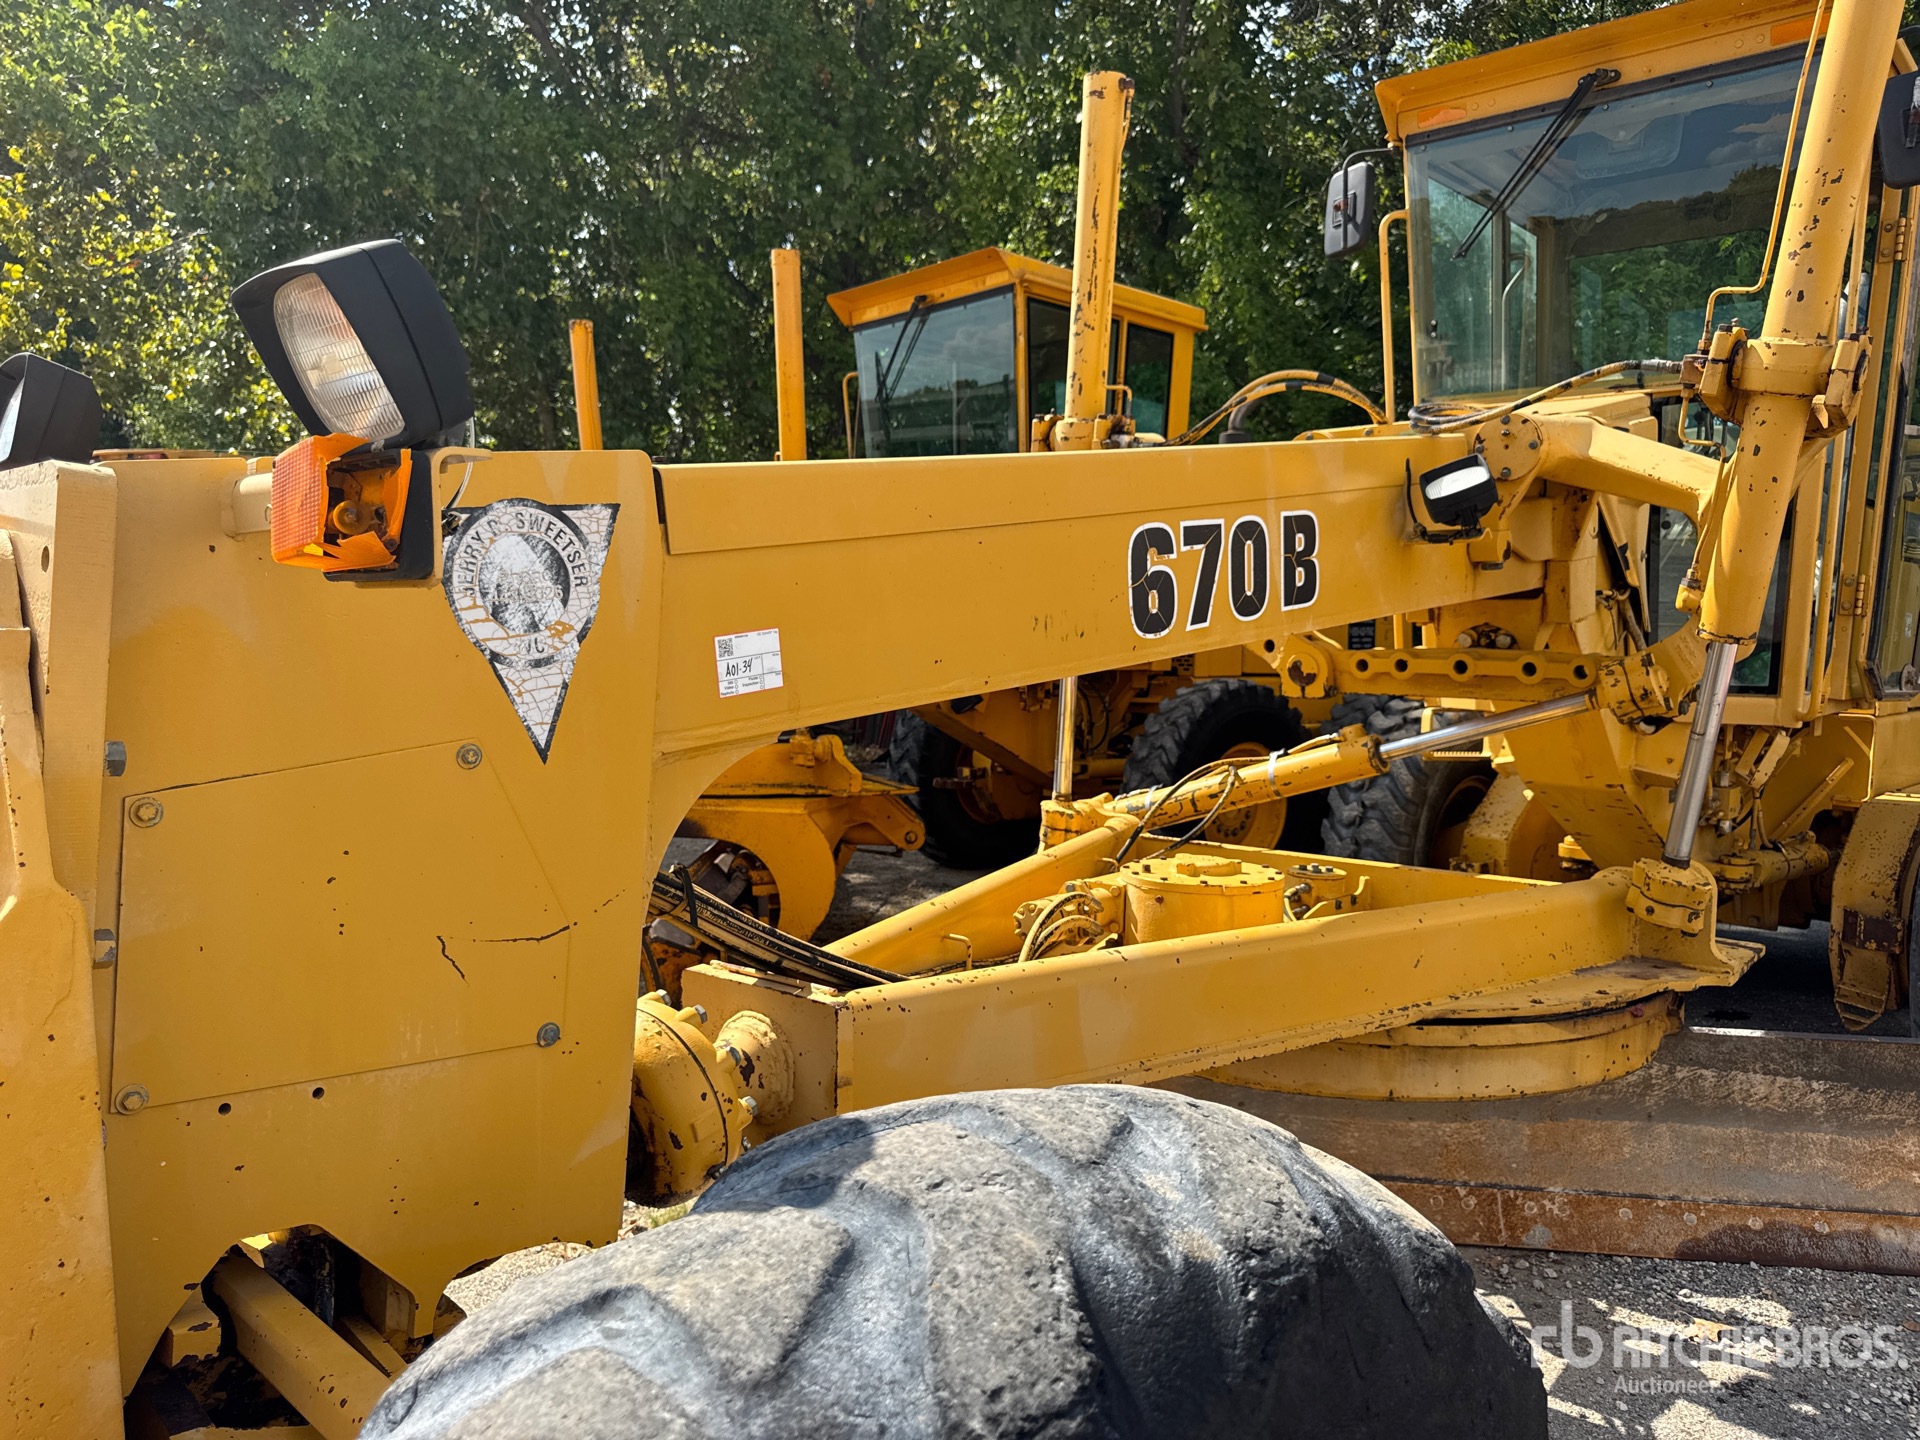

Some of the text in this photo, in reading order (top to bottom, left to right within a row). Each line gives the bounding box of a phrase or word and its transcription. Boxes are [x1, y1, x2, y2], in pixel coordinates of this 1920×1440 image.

[457, 531, 488, 595] JERRY
[514, 511, 589, 588] SWEETSER
[1128, 509, 1320, 640] 670B
[725, 657, 753, 677] A01-34
